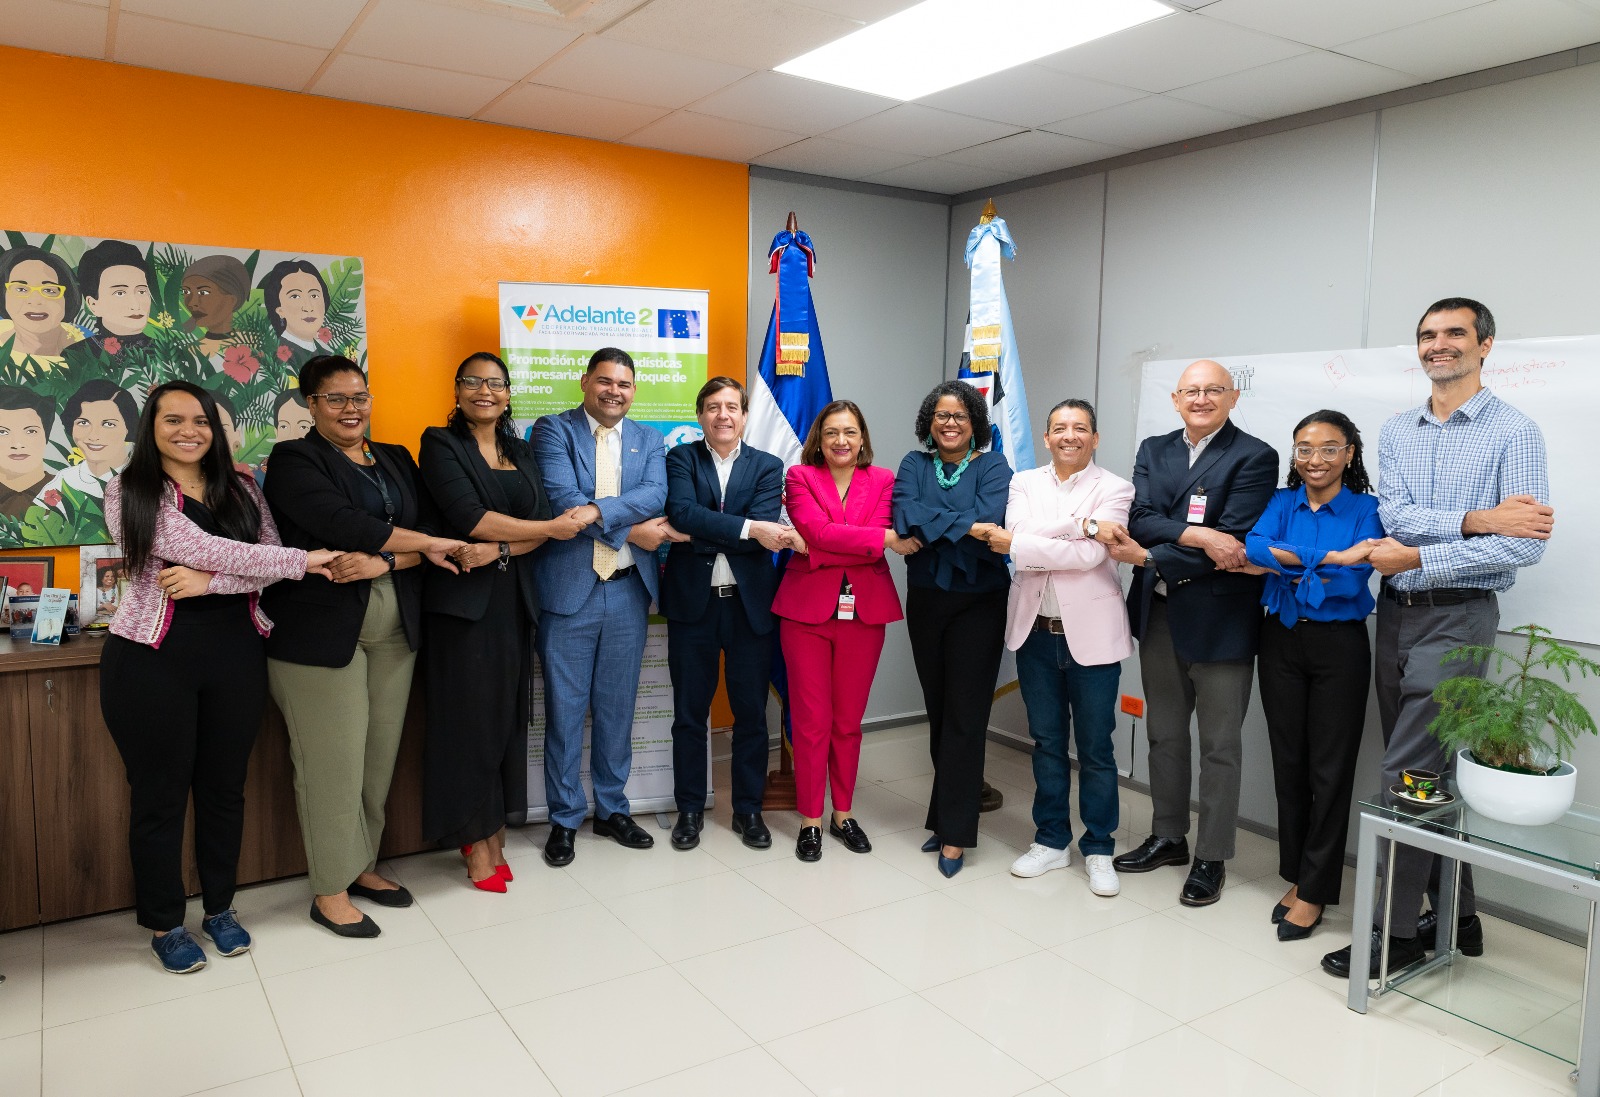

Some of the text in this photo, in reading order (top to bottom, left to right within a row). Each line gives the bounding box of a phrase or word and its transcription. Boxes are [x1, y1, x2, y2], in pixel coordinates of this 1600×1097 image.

[543, 304, 653, 325] Adelante 2
[508, 353, 576, 366] Promoción
[633, 357, 683, 369] adísticas
[509, 369, 687, 385] empresarial foque de
[510, 382, 553, 396] género
